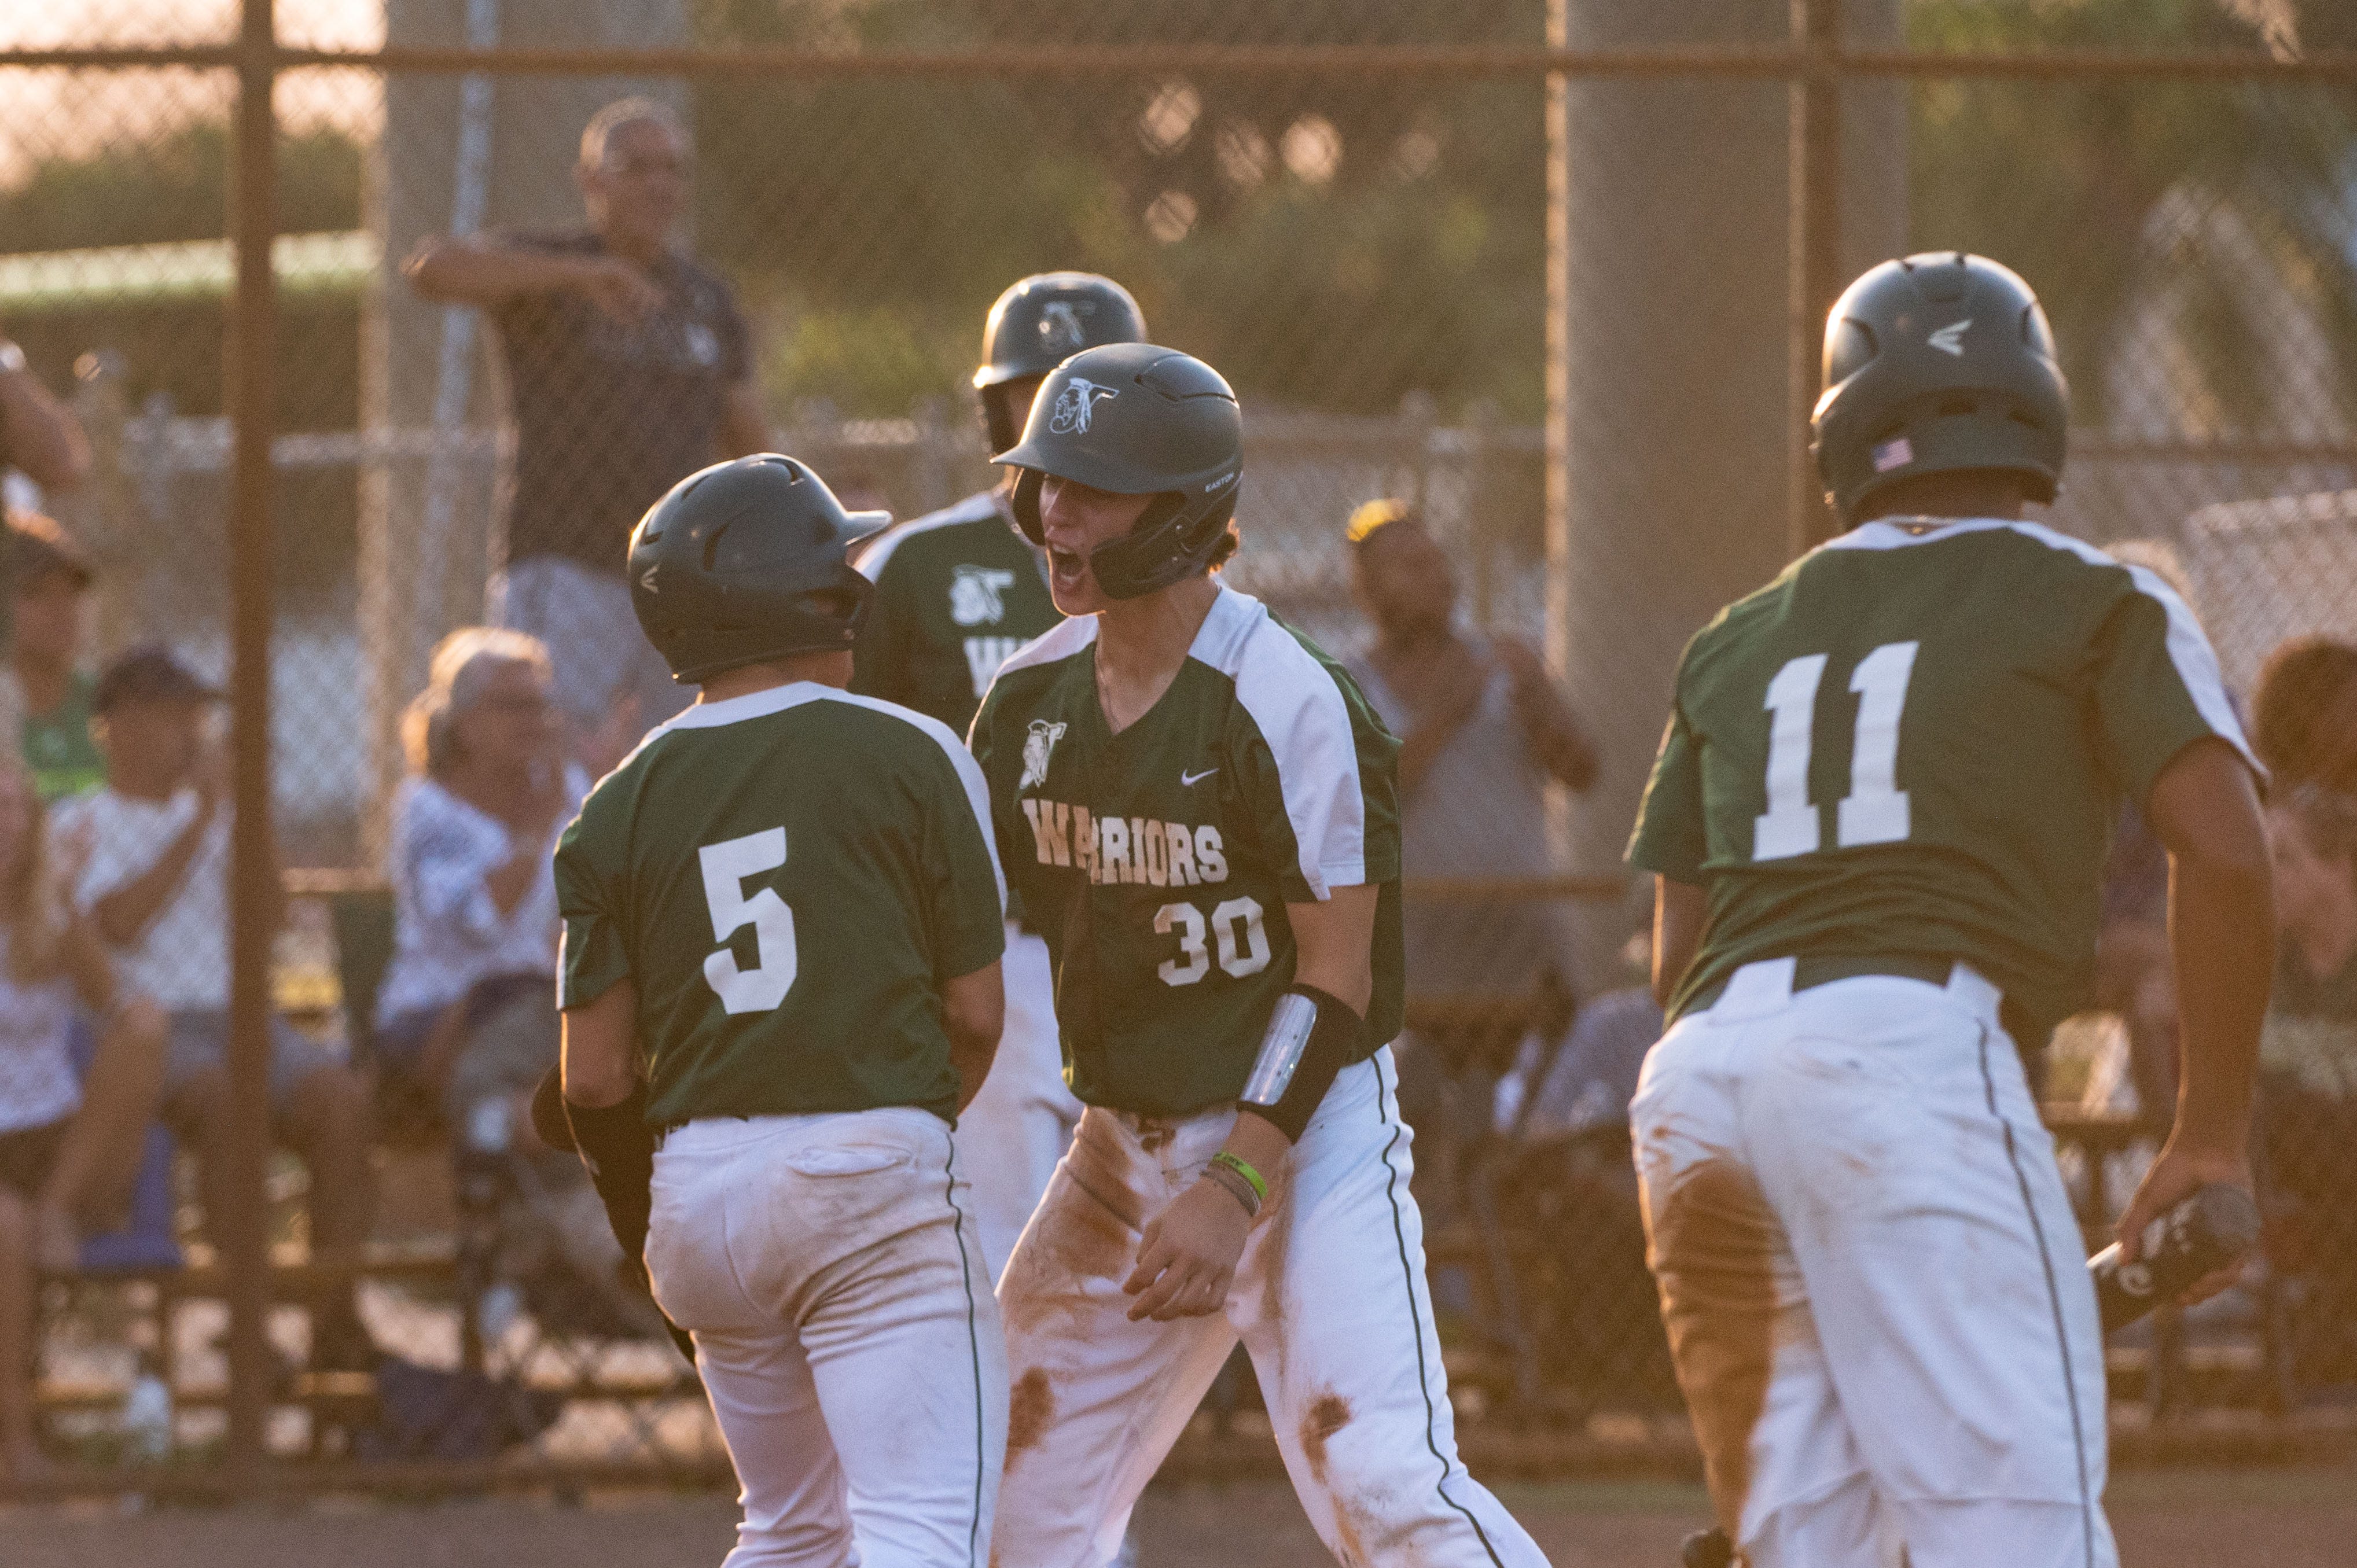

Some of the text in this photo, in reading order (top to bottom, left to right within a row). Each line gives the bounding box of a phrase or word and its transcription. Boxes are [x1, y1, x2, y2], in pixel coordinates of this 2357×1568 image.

[1751, 640, 1920, 862] 11
[698, 826, 797, 1015] 5
[1153, 895, 1271, 986] 30
